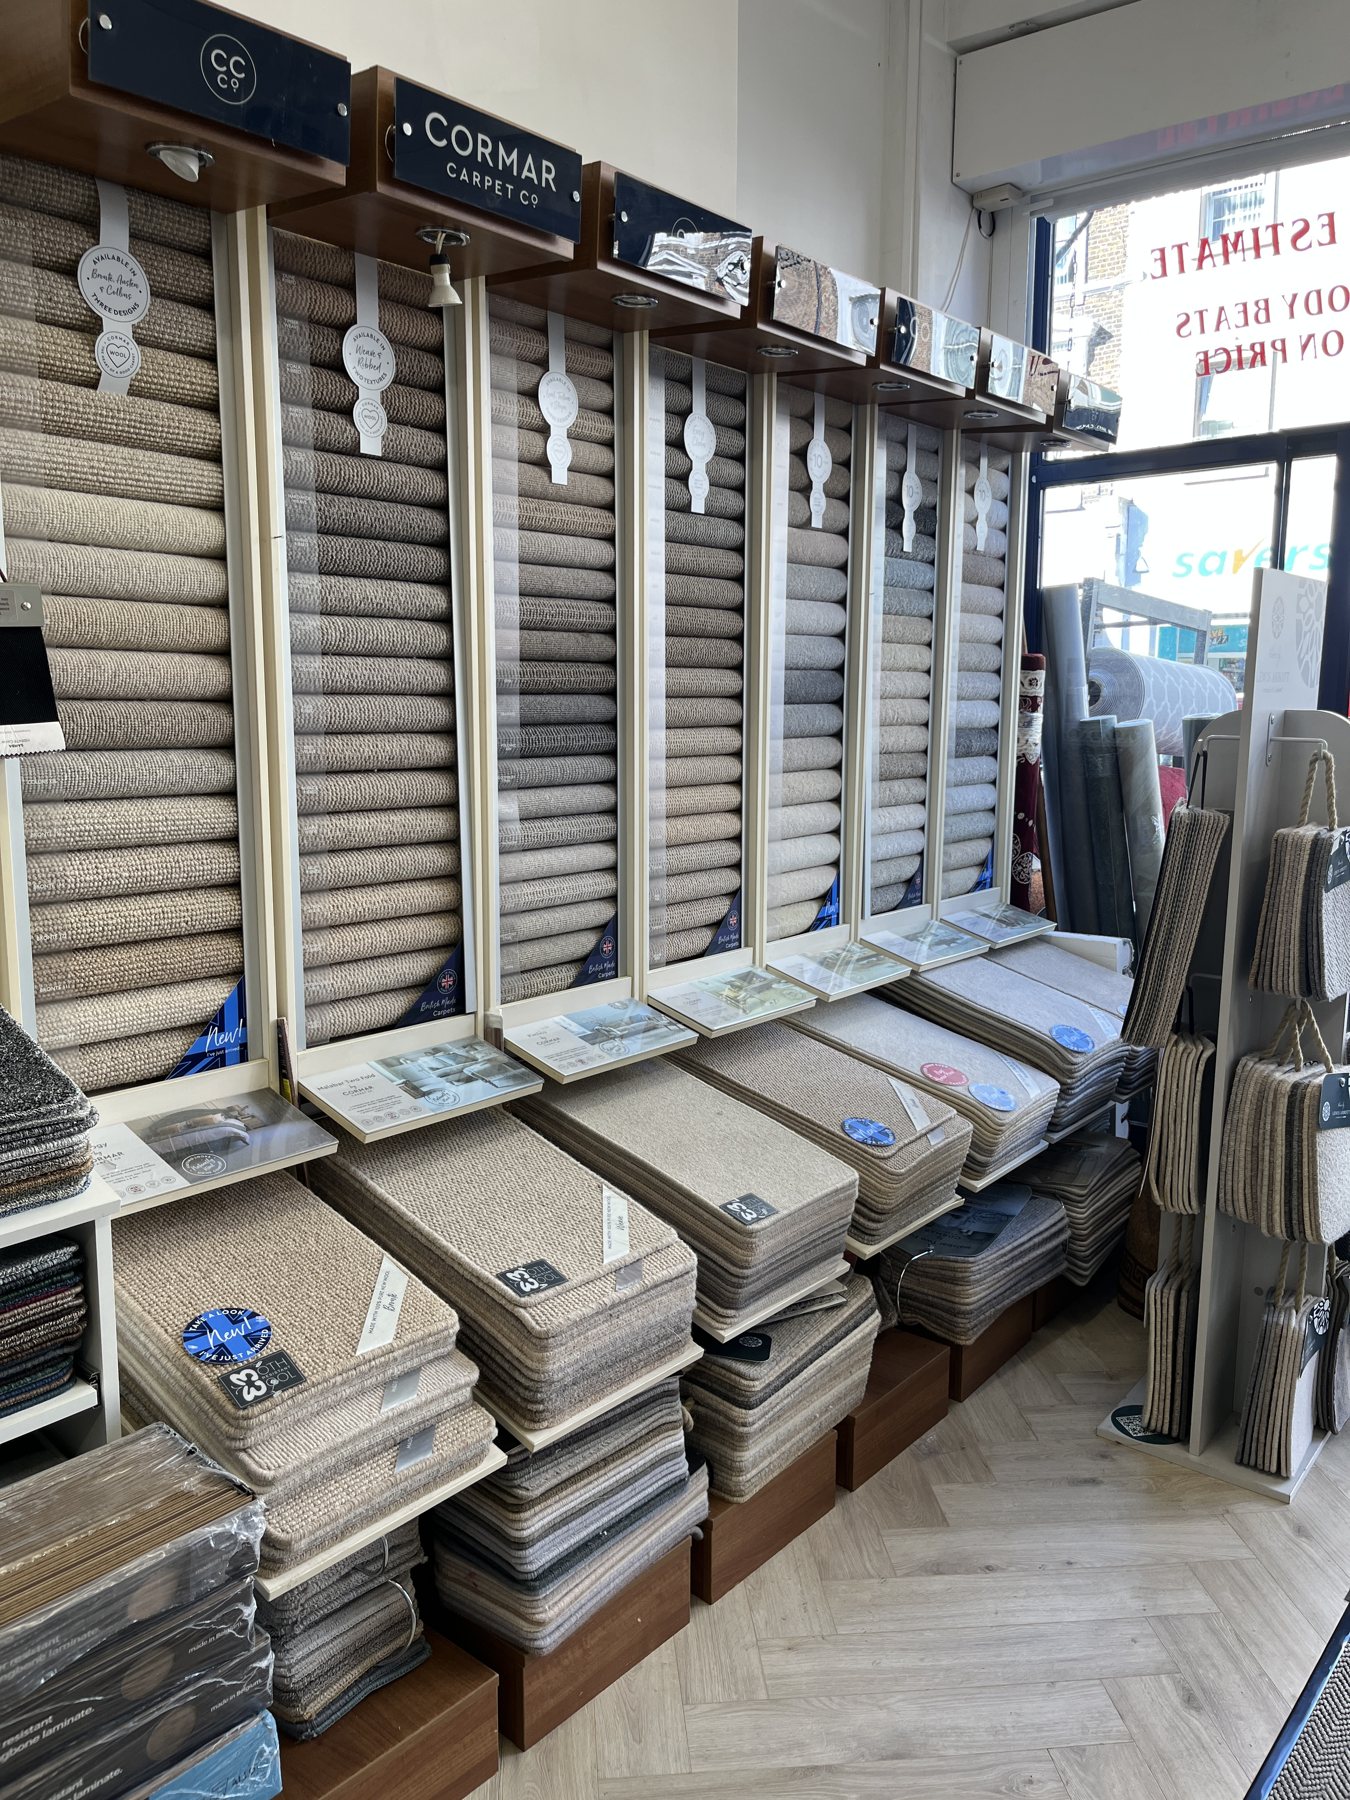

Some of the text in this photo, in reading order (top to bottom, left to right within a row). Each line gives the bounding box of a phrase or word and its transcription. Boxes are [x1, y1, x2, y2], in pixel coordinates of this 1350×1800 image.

[211, 49, 245, 78] CC
[425, 112, 556, 192] CORMAR
[446, 162, 514, 199] CARPET
[92, 253, 137, 277] AVAILABLE IN
[92, 292, 139, 317] THREE DESIGNS
[353, 331, 386, 351] AVAILABLE IN
[355, 344, 376, 358] Weave
[110, 350, 127, 358] WOOL
[357, 356, 382, 373] Ribbed
[352, 366, 387, 384] TWO TEXTURES
[433, 1008, 456, 1017] Carpets
[205, 1018, 243, 1053] New!
[342, 1085, 373, 1096] CORMAR
[189, 1317, 207, 1331] TAKE
[207, 1316, 253, 1349] New!
[199, 1328, 269, 1361] I'VE JUST ARRIVED
[262, 1365, 291, 1379] RESISTANT
[10, 1635, 60, 1668] resistant
[2, 1715, 53, 1749] resistant
[42, 1706, 95, 1740] laminate.
